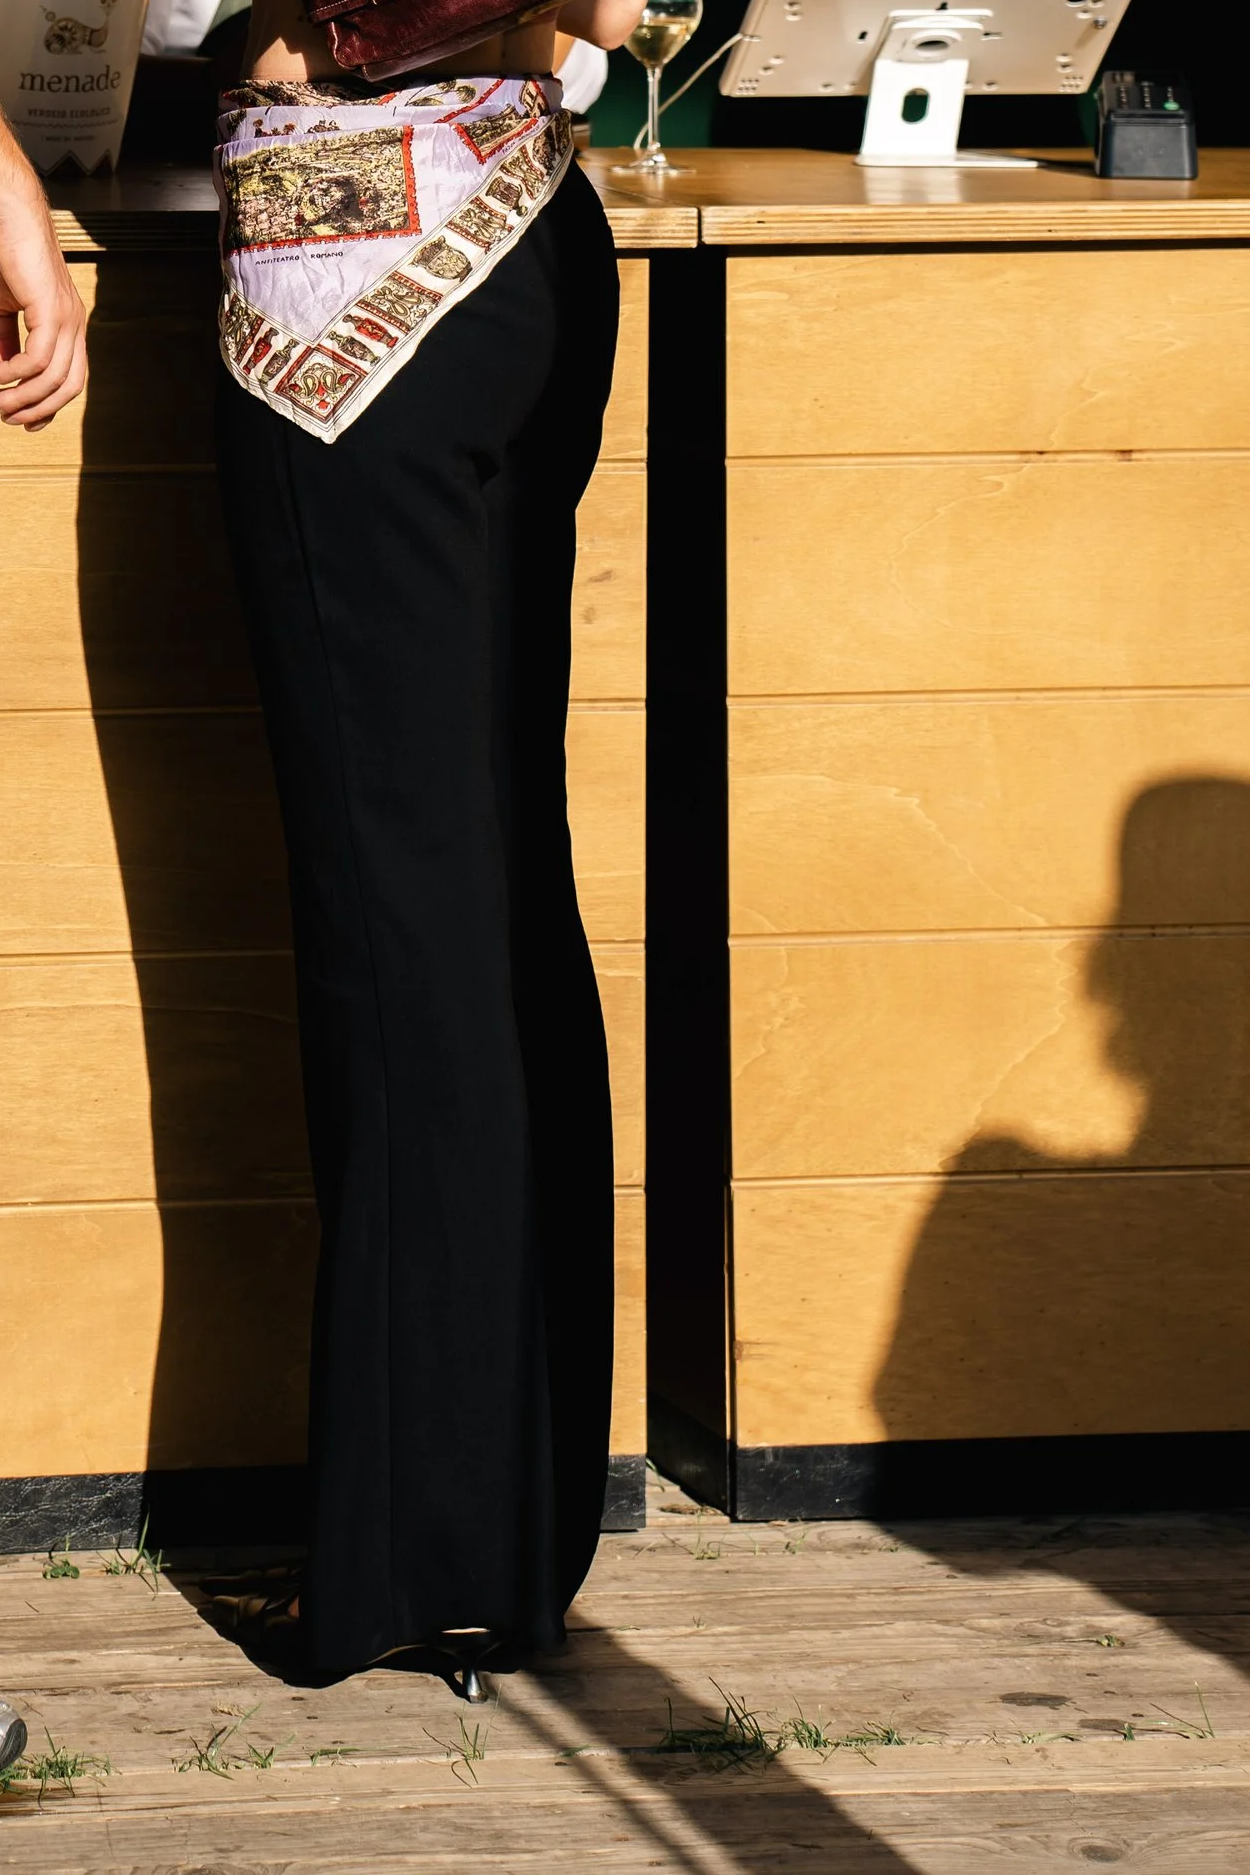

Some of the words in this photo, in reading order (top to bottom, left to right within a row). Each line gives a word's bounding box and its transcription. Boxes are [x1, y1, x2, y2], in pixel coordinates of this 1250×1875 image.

[18, 64, 121, 93] menade
[255, 255, 300, 266] ANFITEATRO
[310, 251, 344, 260] ROMANO
